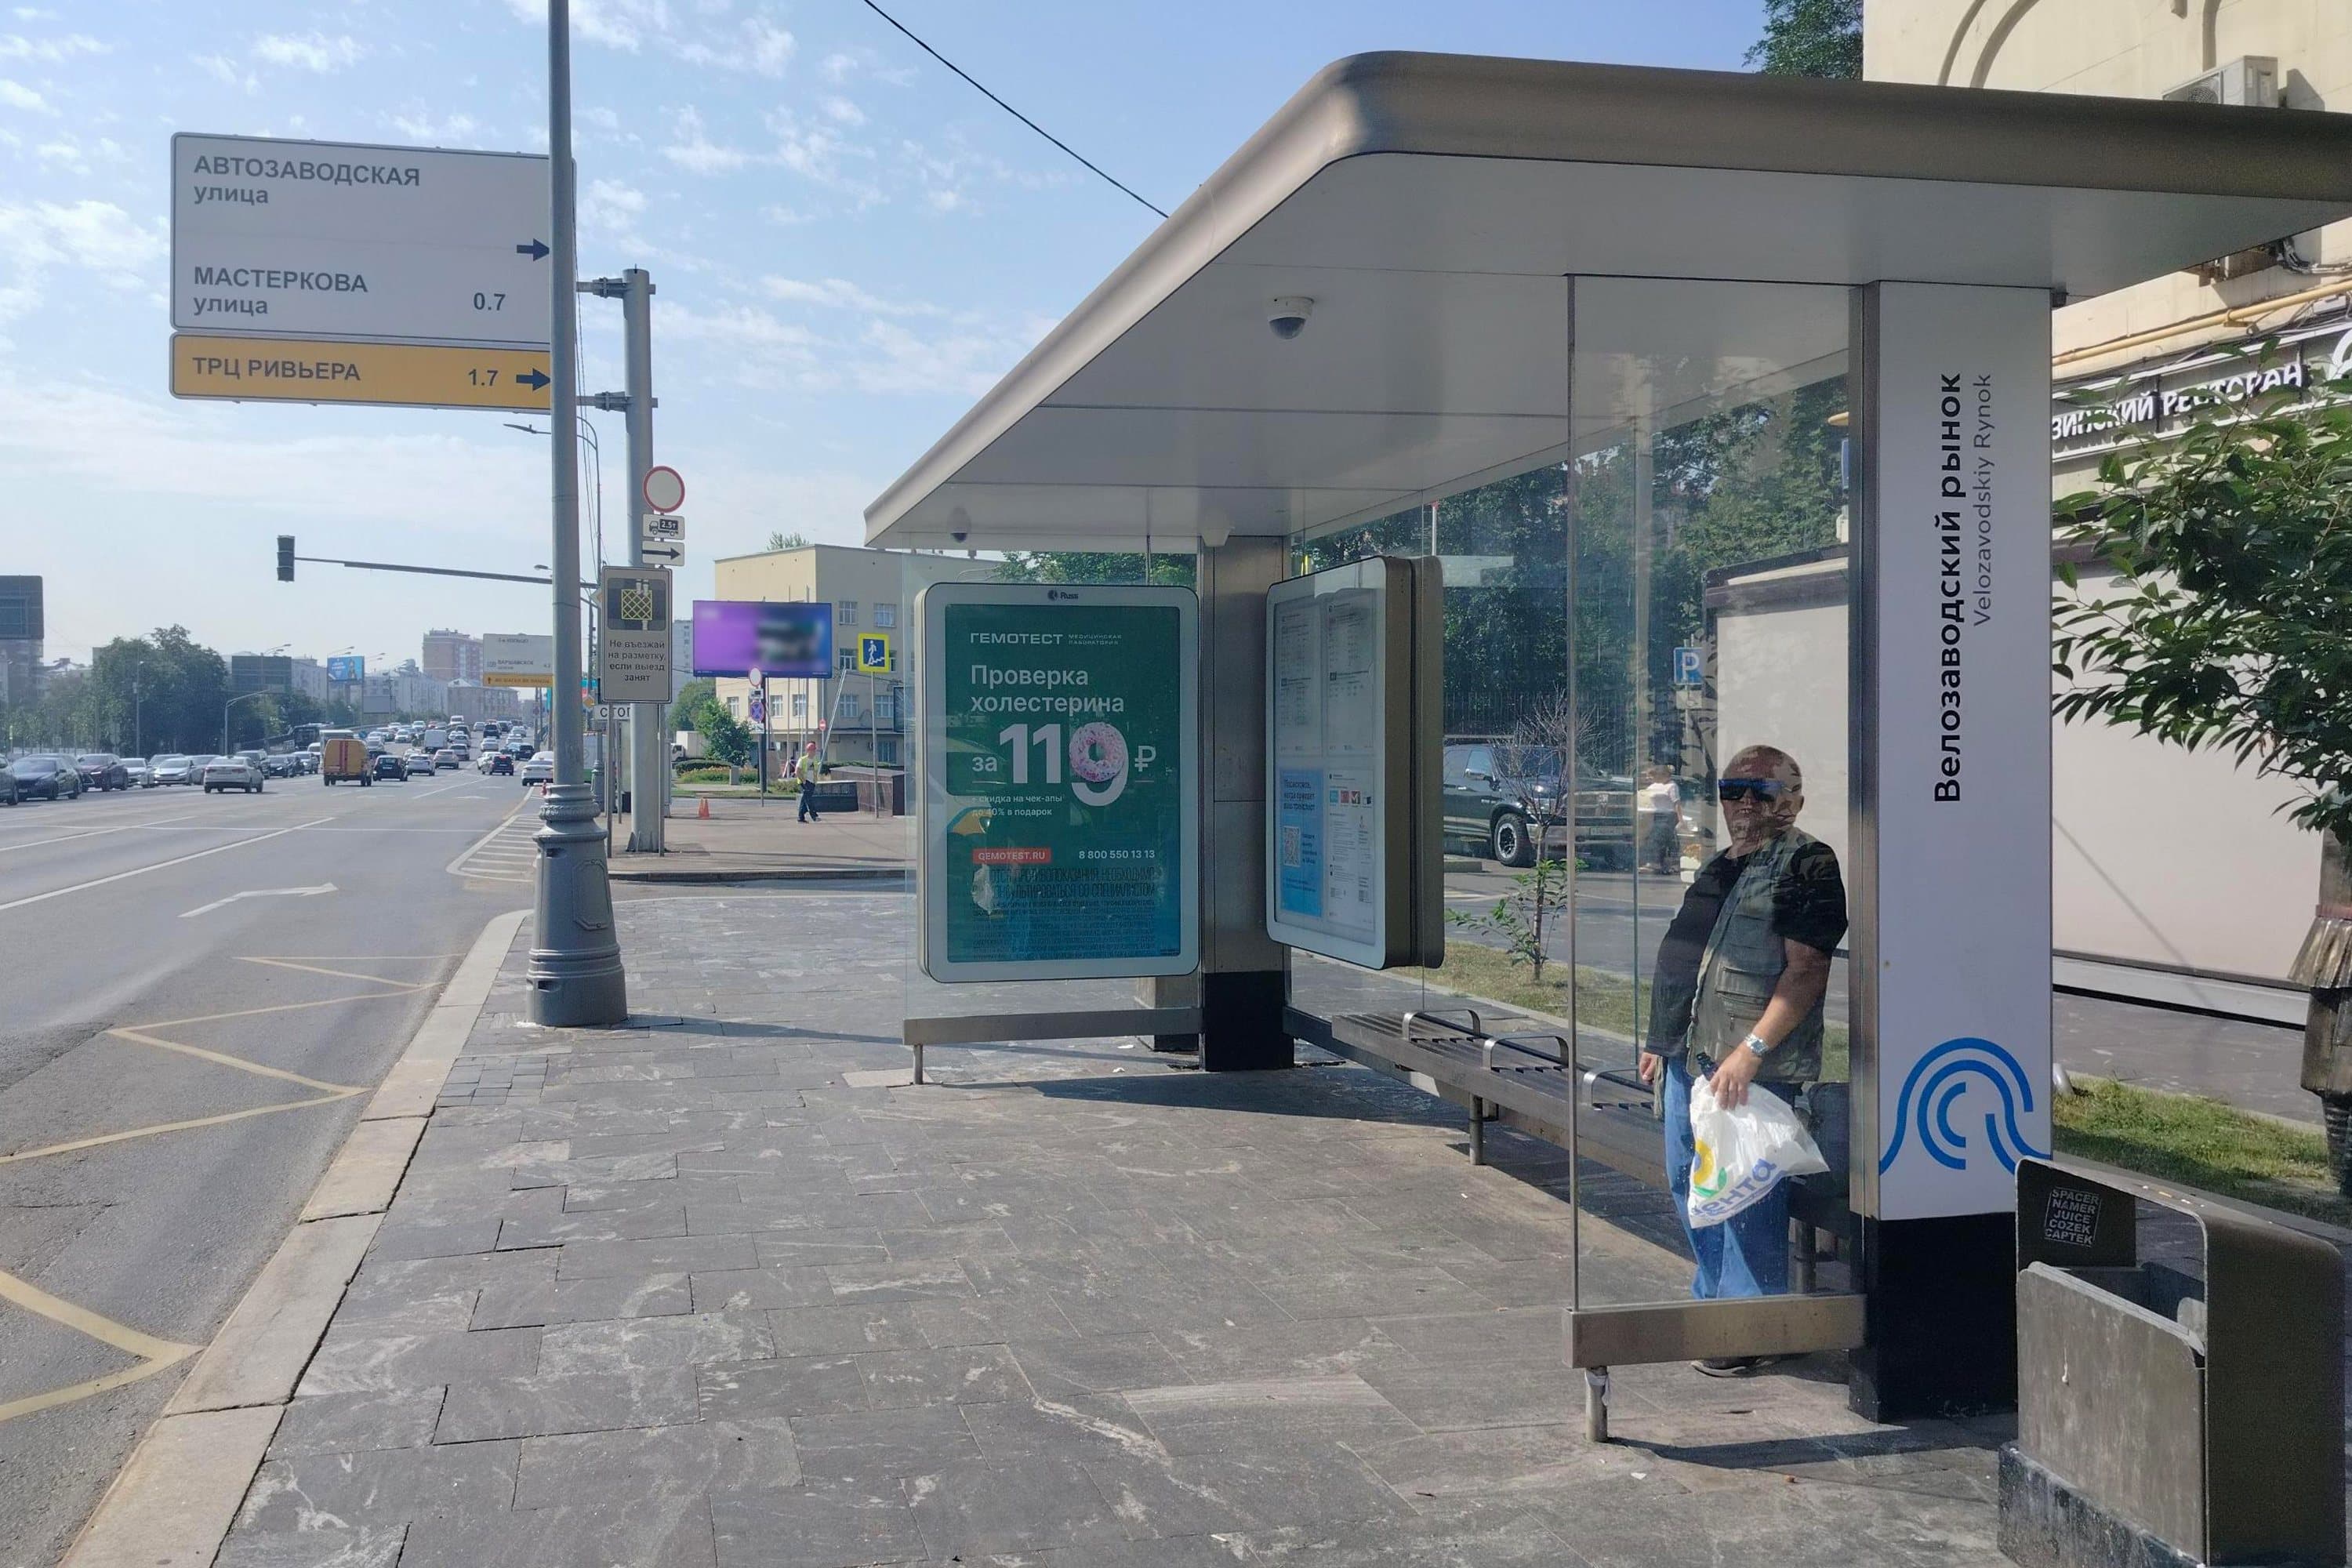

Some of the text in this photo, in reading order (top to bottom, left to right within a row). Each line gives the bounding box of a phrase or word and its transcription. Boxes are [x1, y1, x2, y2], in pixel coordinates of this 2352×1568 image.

[194, 154, 420, 187] АВТОЗАВОДСКАЯ
[194, 186, 268, 205] улица
[194, 267, 368, 292] МАСТЕРКОВА
[193, 297, 268, 316] улица
[474, 292, 506, 311] 0.7
[193, 357, 361, 381] ТРЦ РИВЬЕРА
[467, 369, 498, 387] 1.7
[1973, 373, 1995, 627] Velozavodskiy Rynok
[1933, 372, 1966, 802] Велозаводский рынок
[609, 639, 622, 648] Не
[970, 633, 1063, 645] ГЕМОТЕСТ
[971, 665, 1088, 690] Проверка
[600, 707, 630, 718] СО
[971, 696, 1124, 717] холестерина
[972, 756, 998, 772] за
[999, 722, 1130, 807] 119
[1014, 808, 1052, 817] подарок
[978, 851, 1045, 861] GEMOTEST.RU
[1079, 849, 1156, 859] 8 800 550 13 13
[2052, 1189, 2100, 1205] SPACER
[2052, 1199, 2096, 1214] NAMER
[2053, 1210, 2091, 1224] JUICE
[2049, 1219, 2092, 1234] COZEK
[2045, 1229, 2093, 1245] CAPTEK
